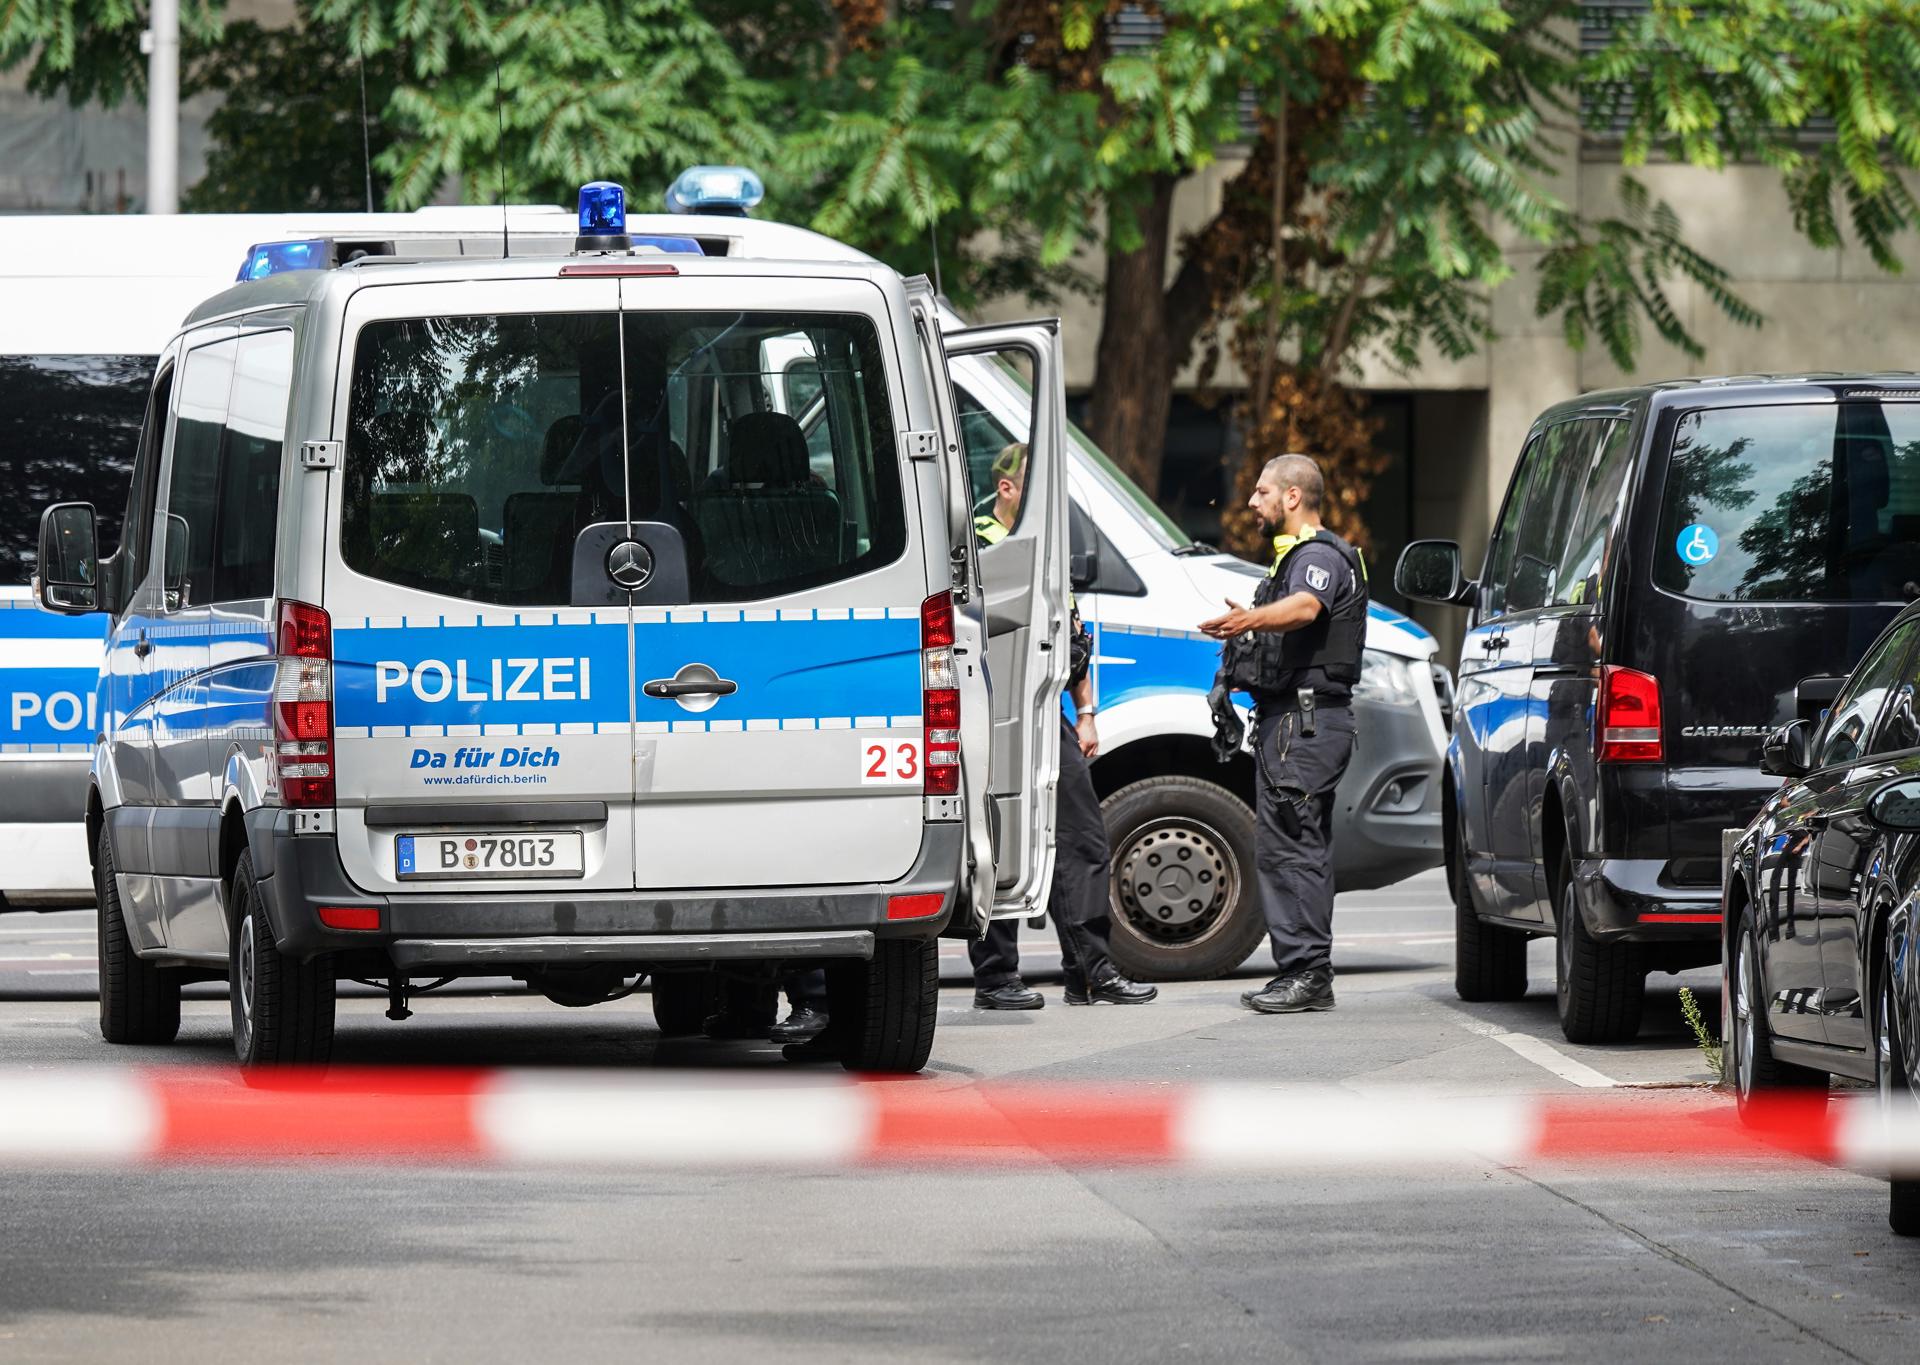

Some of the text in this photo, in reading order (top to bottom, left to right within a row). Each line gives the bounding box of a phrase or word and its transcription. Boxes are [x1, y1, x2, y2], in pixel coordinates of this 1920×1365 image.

[376, 657, 590, 703] POLIZEI
[410, 746, 560, 769] Da für Dich
[866, 743, 918, 779] 23
[423, 774, 547, 785] www.dafürdich.berlin
[403, 858, 411, 868] D
[440, 839, 554, 868] B 7803
